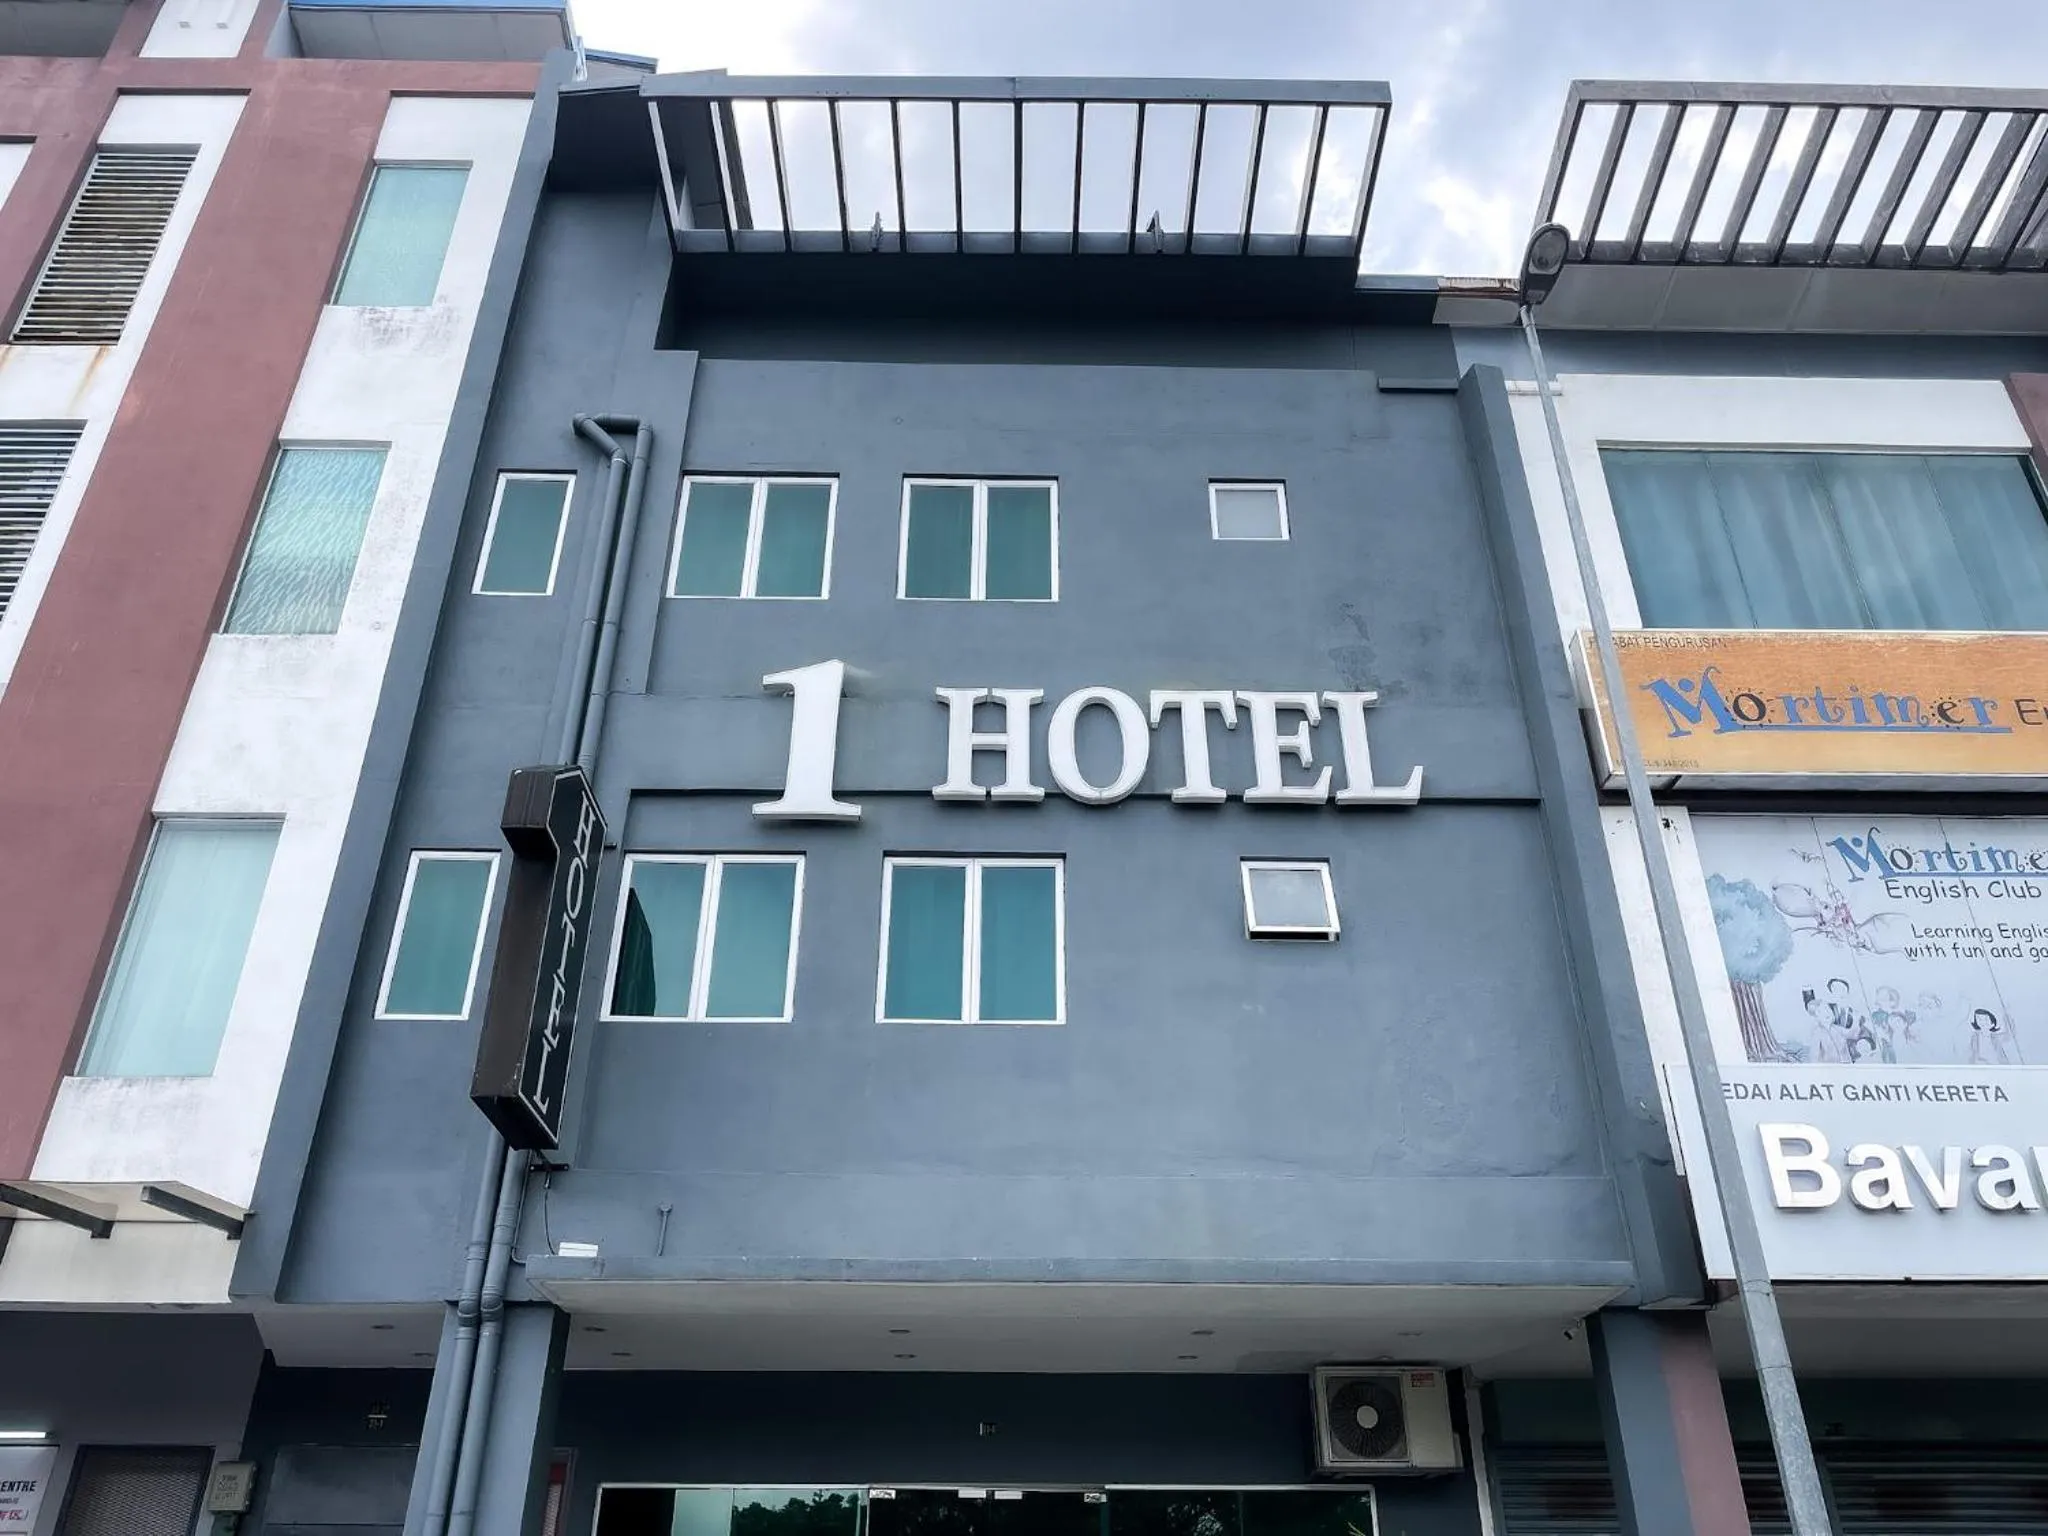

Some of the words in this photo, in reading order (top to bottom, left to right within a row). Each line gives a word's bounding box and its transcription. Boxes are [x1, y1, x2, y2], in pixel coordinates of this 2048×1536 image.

[1638, 666, 2000, 738] Mortimer
[2014, 698, 2048, 726] E
[752, 659, 862, 822] 1
[932, 686, 1424, 806] HOTEL
[1885, 879, 1979, 904] English
[1988, 880, 2042, 899] Club
[1911, 923, 1993, 943] Learning
[533, 791, 597, 1115] HOTEL
[1904, 942, 1952, 961] with
[1952, 942, 1985, 959] fun
[1990, 944, 2024, 959] and
[1721, 1083, 1772, 1101] EDAI
[1779, 1083, 1835, 1102] ALAT
[1843, 1084, 1911, 1102] GANTI
[1917, 1085, 2010, 1103] KERETA
[0, 1480, 38, 1493] ENTRE
